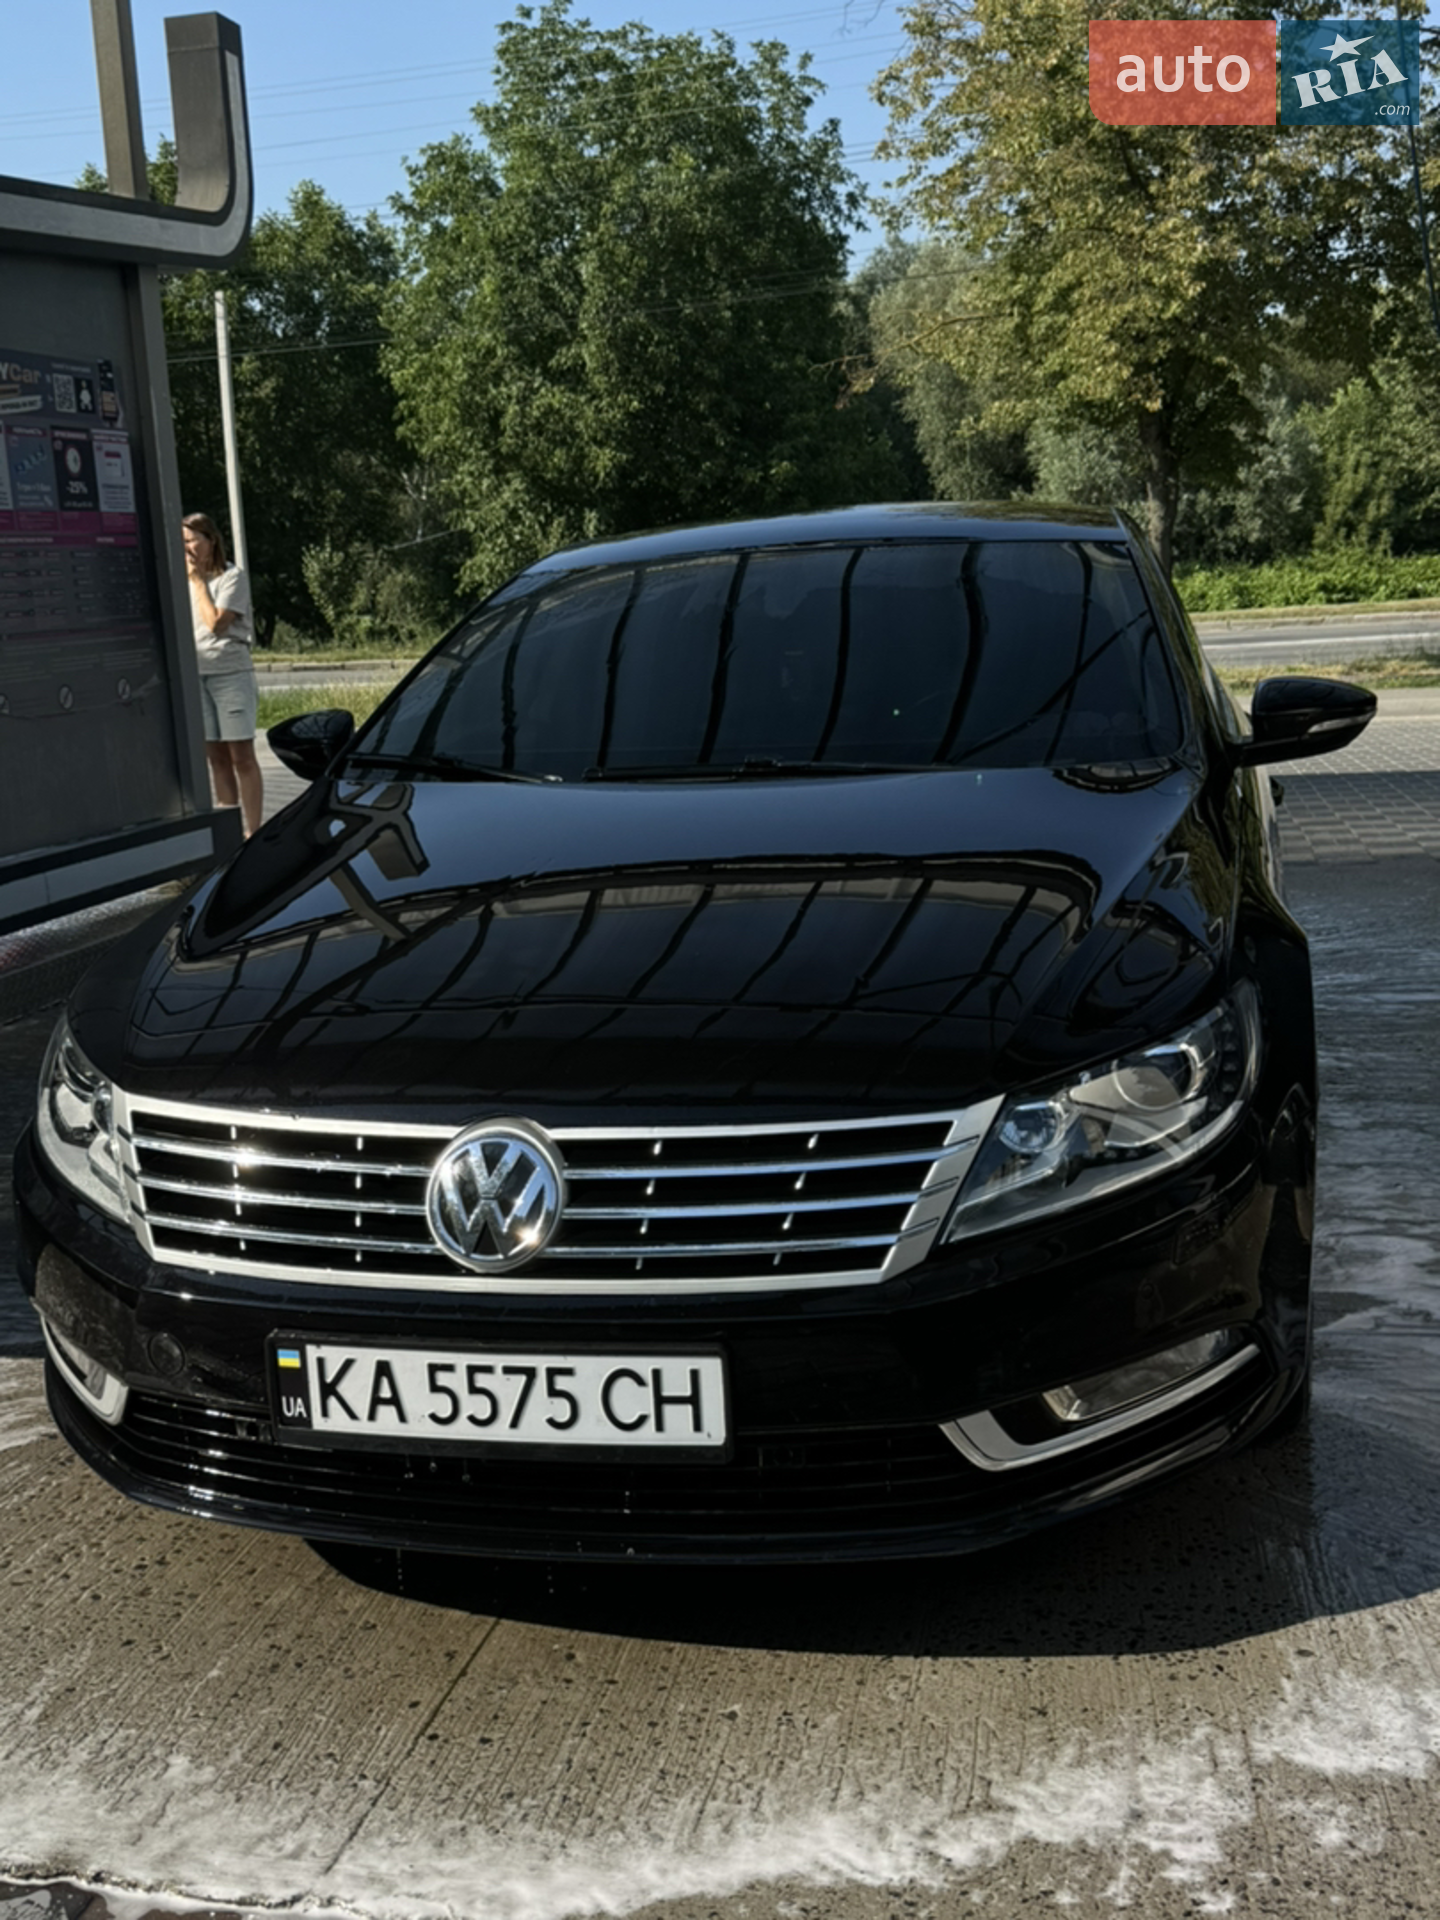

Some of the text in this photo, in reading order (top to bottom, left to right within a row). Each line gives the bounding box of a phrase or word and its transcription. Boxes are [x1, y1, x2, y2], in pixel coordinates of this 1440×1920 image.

[281, 1396, 308, 1419] UA
[315, 1356, 703, 1433] KA 5575 CH
